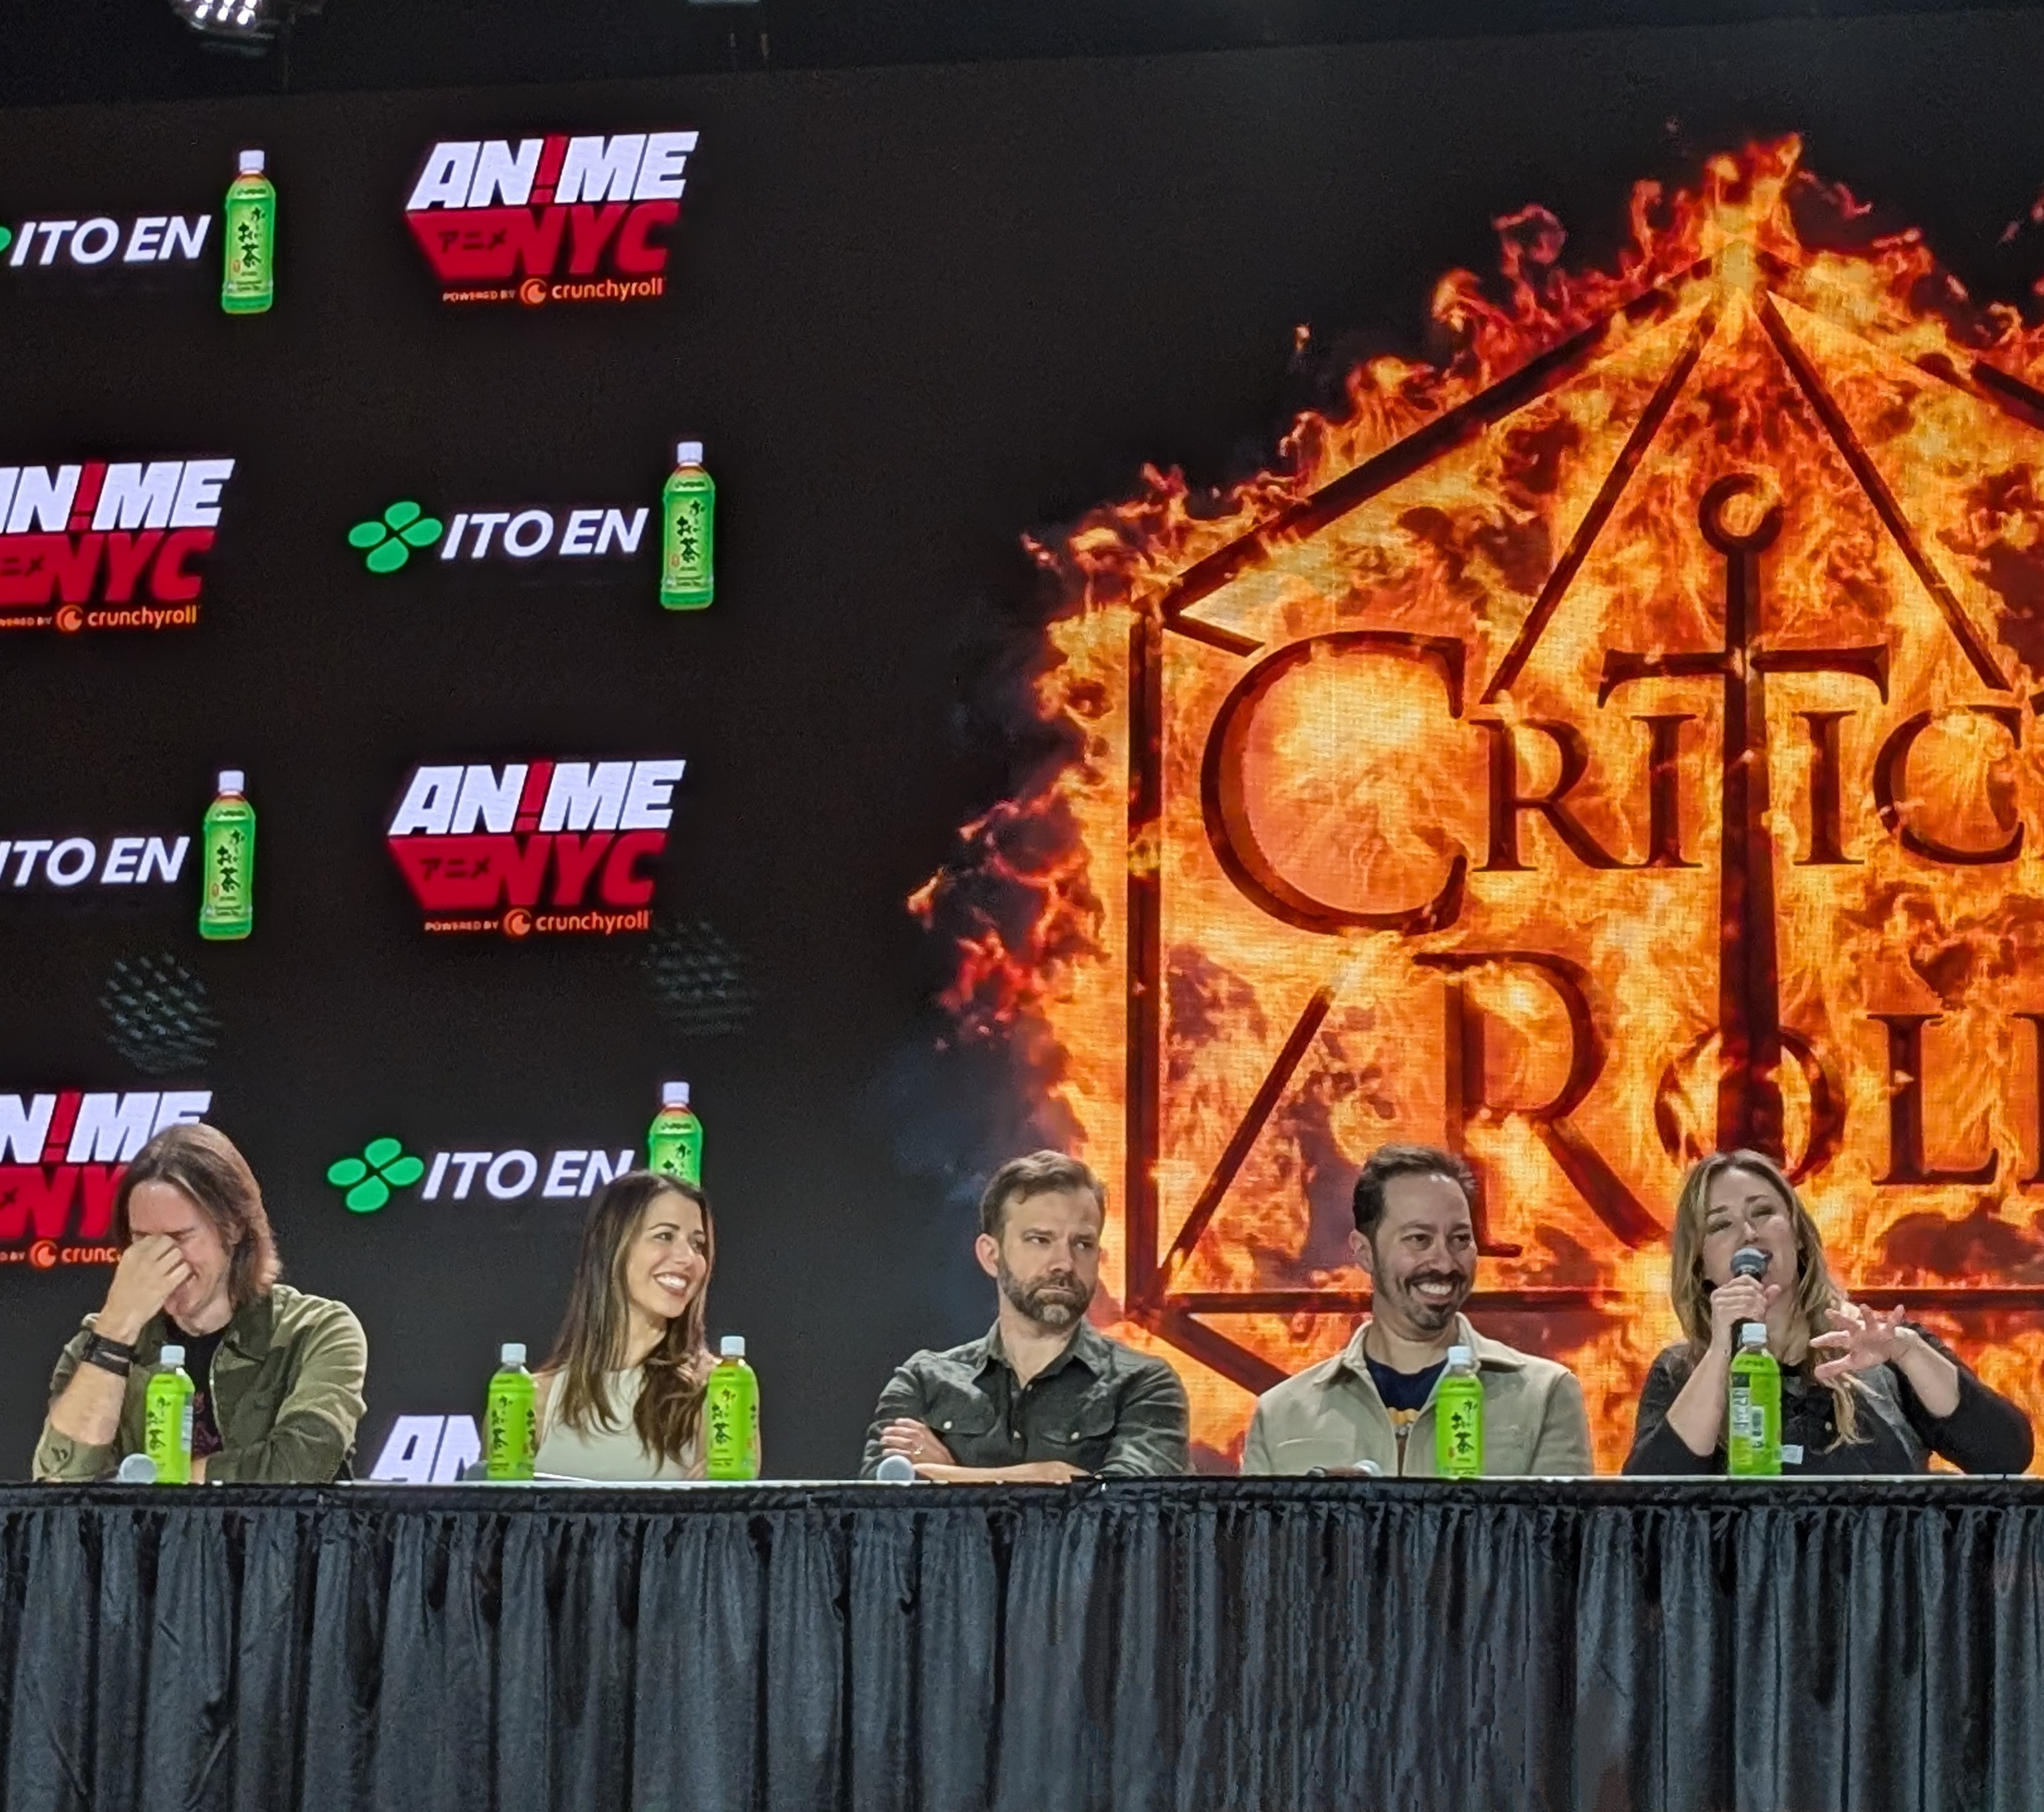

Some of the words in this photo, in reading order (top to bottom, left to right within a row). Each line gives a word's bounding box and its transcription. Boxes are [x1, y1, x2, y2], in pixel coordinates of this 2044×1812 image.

[10, 218, 120, 266] ITO
[123, 215, 212, 262] EN
[437, 229, 508, 253] アニメ
[511, 202, 679, 275] NYC
[551, 277, 663, 302] crunchyroll
[440, 510, 554, 559] ITO
[559, 508, 649, 555] EN
[48, 529, 217, 603] NYC
[87, 605, 197, 630] crunchyroll
[1199, 629, 2044, 934] CRITIC
[100, 837, 190, 885] EN
[419, 857, 490, 881] アニメ
[495, 833, 668, 905] NYC
[536, 911, 650, 935] crunchyroll
[1412, 950, 2044, 1257] ROL
[422, 1149, 537, 1199] ITO
[542, 1150, 634, 1197] EN
